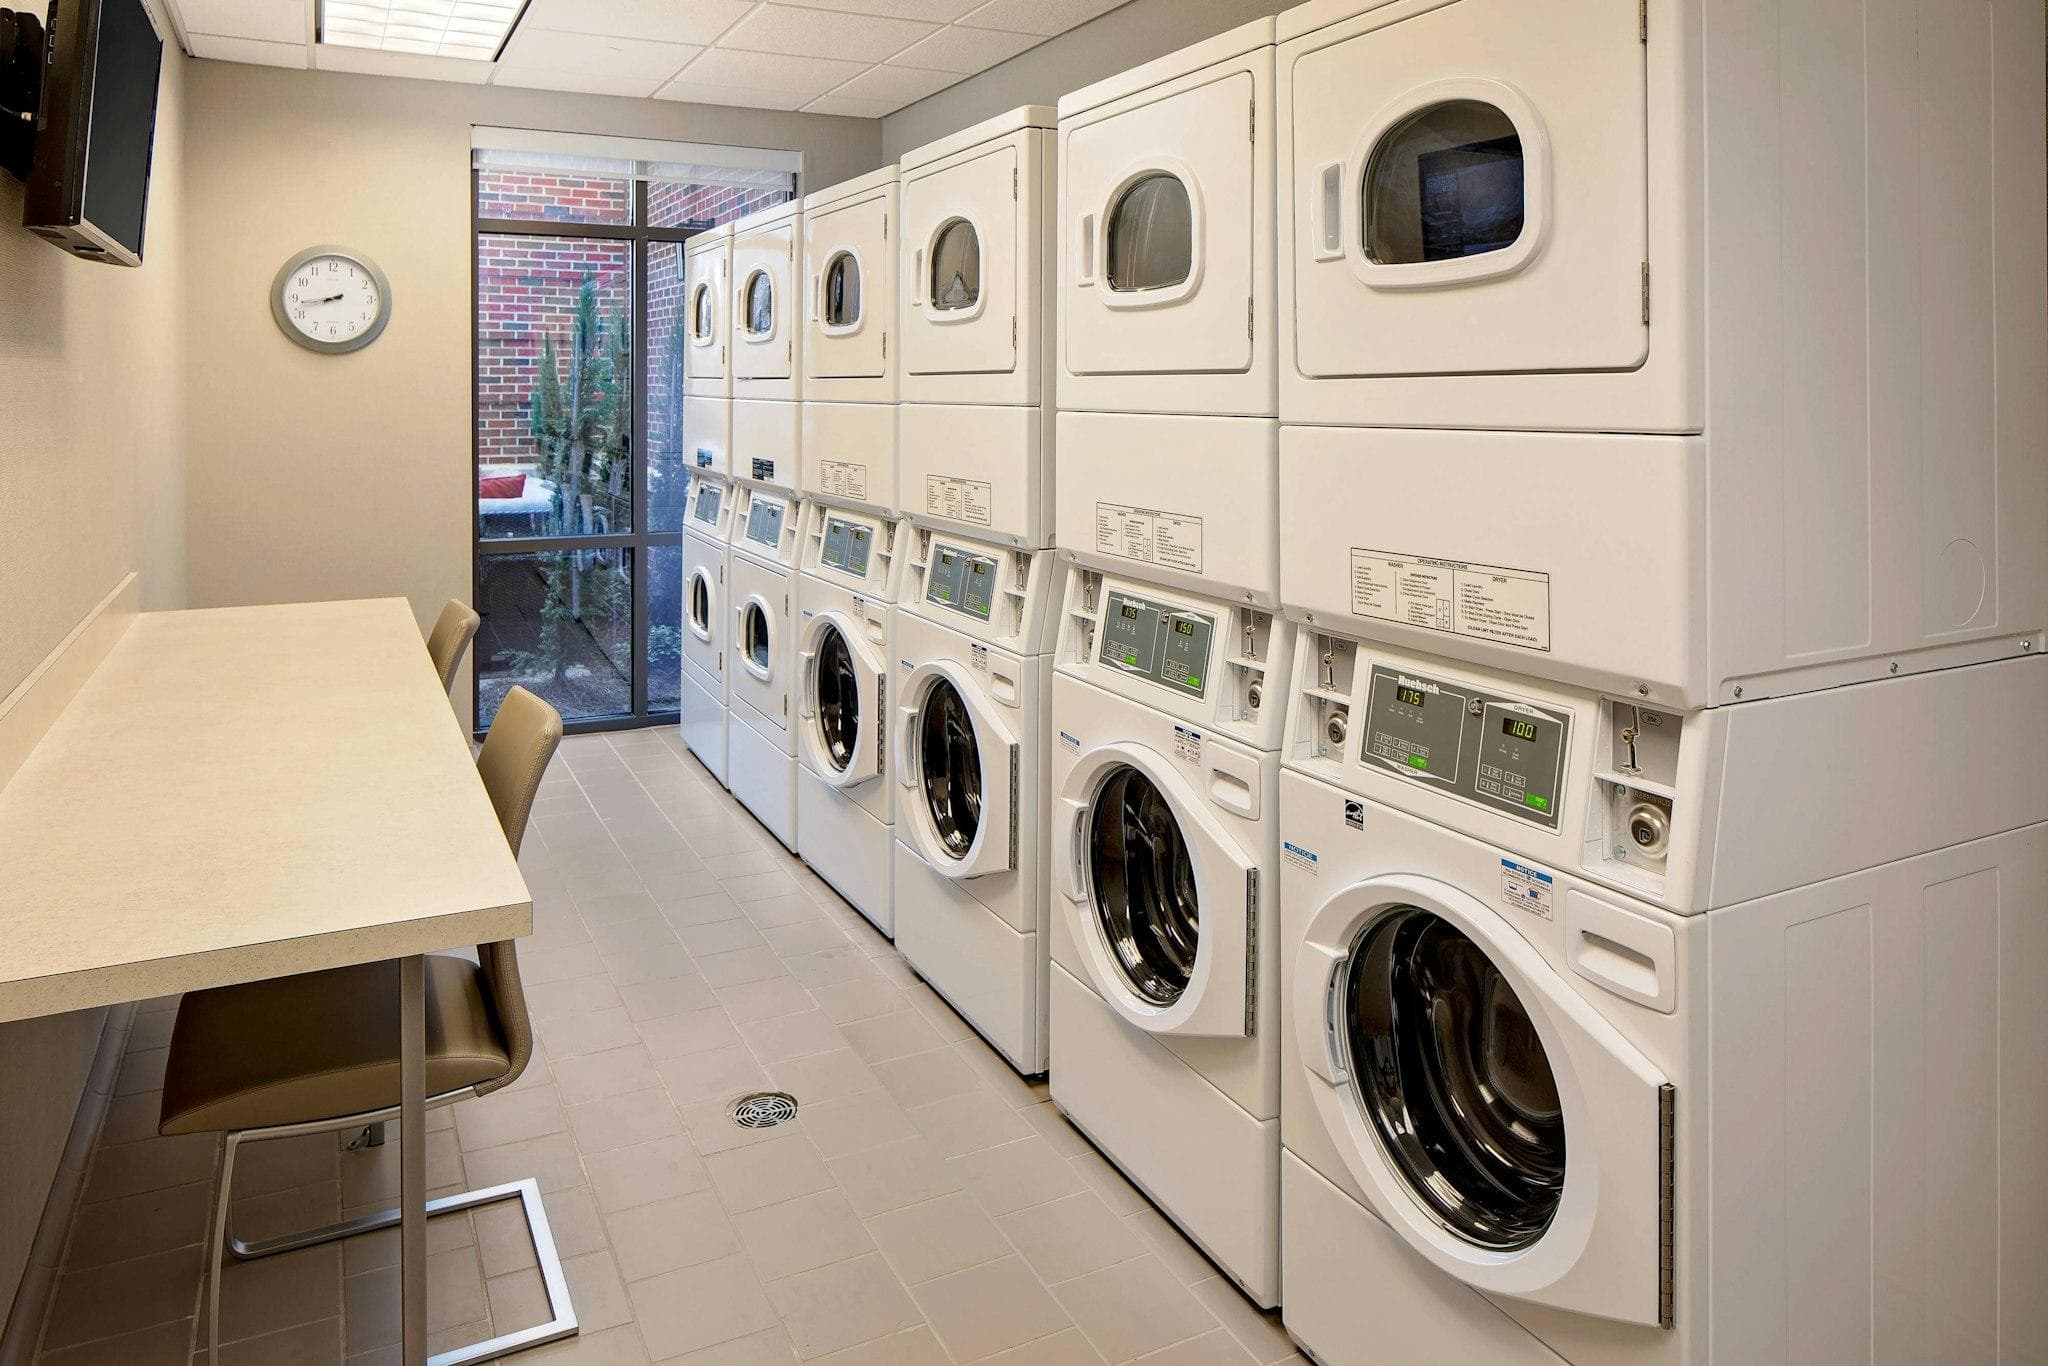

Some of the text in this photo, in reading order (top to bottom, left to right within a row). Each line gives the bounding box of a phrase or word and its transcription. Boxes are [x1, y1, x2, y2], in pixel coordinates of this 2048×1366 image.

[328, 262, 338, 271] 12
[312, 267, 318, 276] 11
[299, 278, 308, 287] 10
[362, 280, 368, 289] 2
[292, 294, 298, 302] 9
[367, 296, 372, 304] 3
[298, 310, 305, 319] 8
[361, 312, 366, 320] 4
[313, 322, 318, 331] 7
[330, 326, 336, 335] 6
[349, 322, 354, 331] 5
[1398, 675, 1440, 694] Huebsch
[1403, 690, 1420, 704] 175
[1514, 705, 1534, 714] DRYER
[1513, 721, 1533, 738] 100
[1397, 763, 1418, 775] WASHER
[1516, 865, 1537, 877] NOTICE
